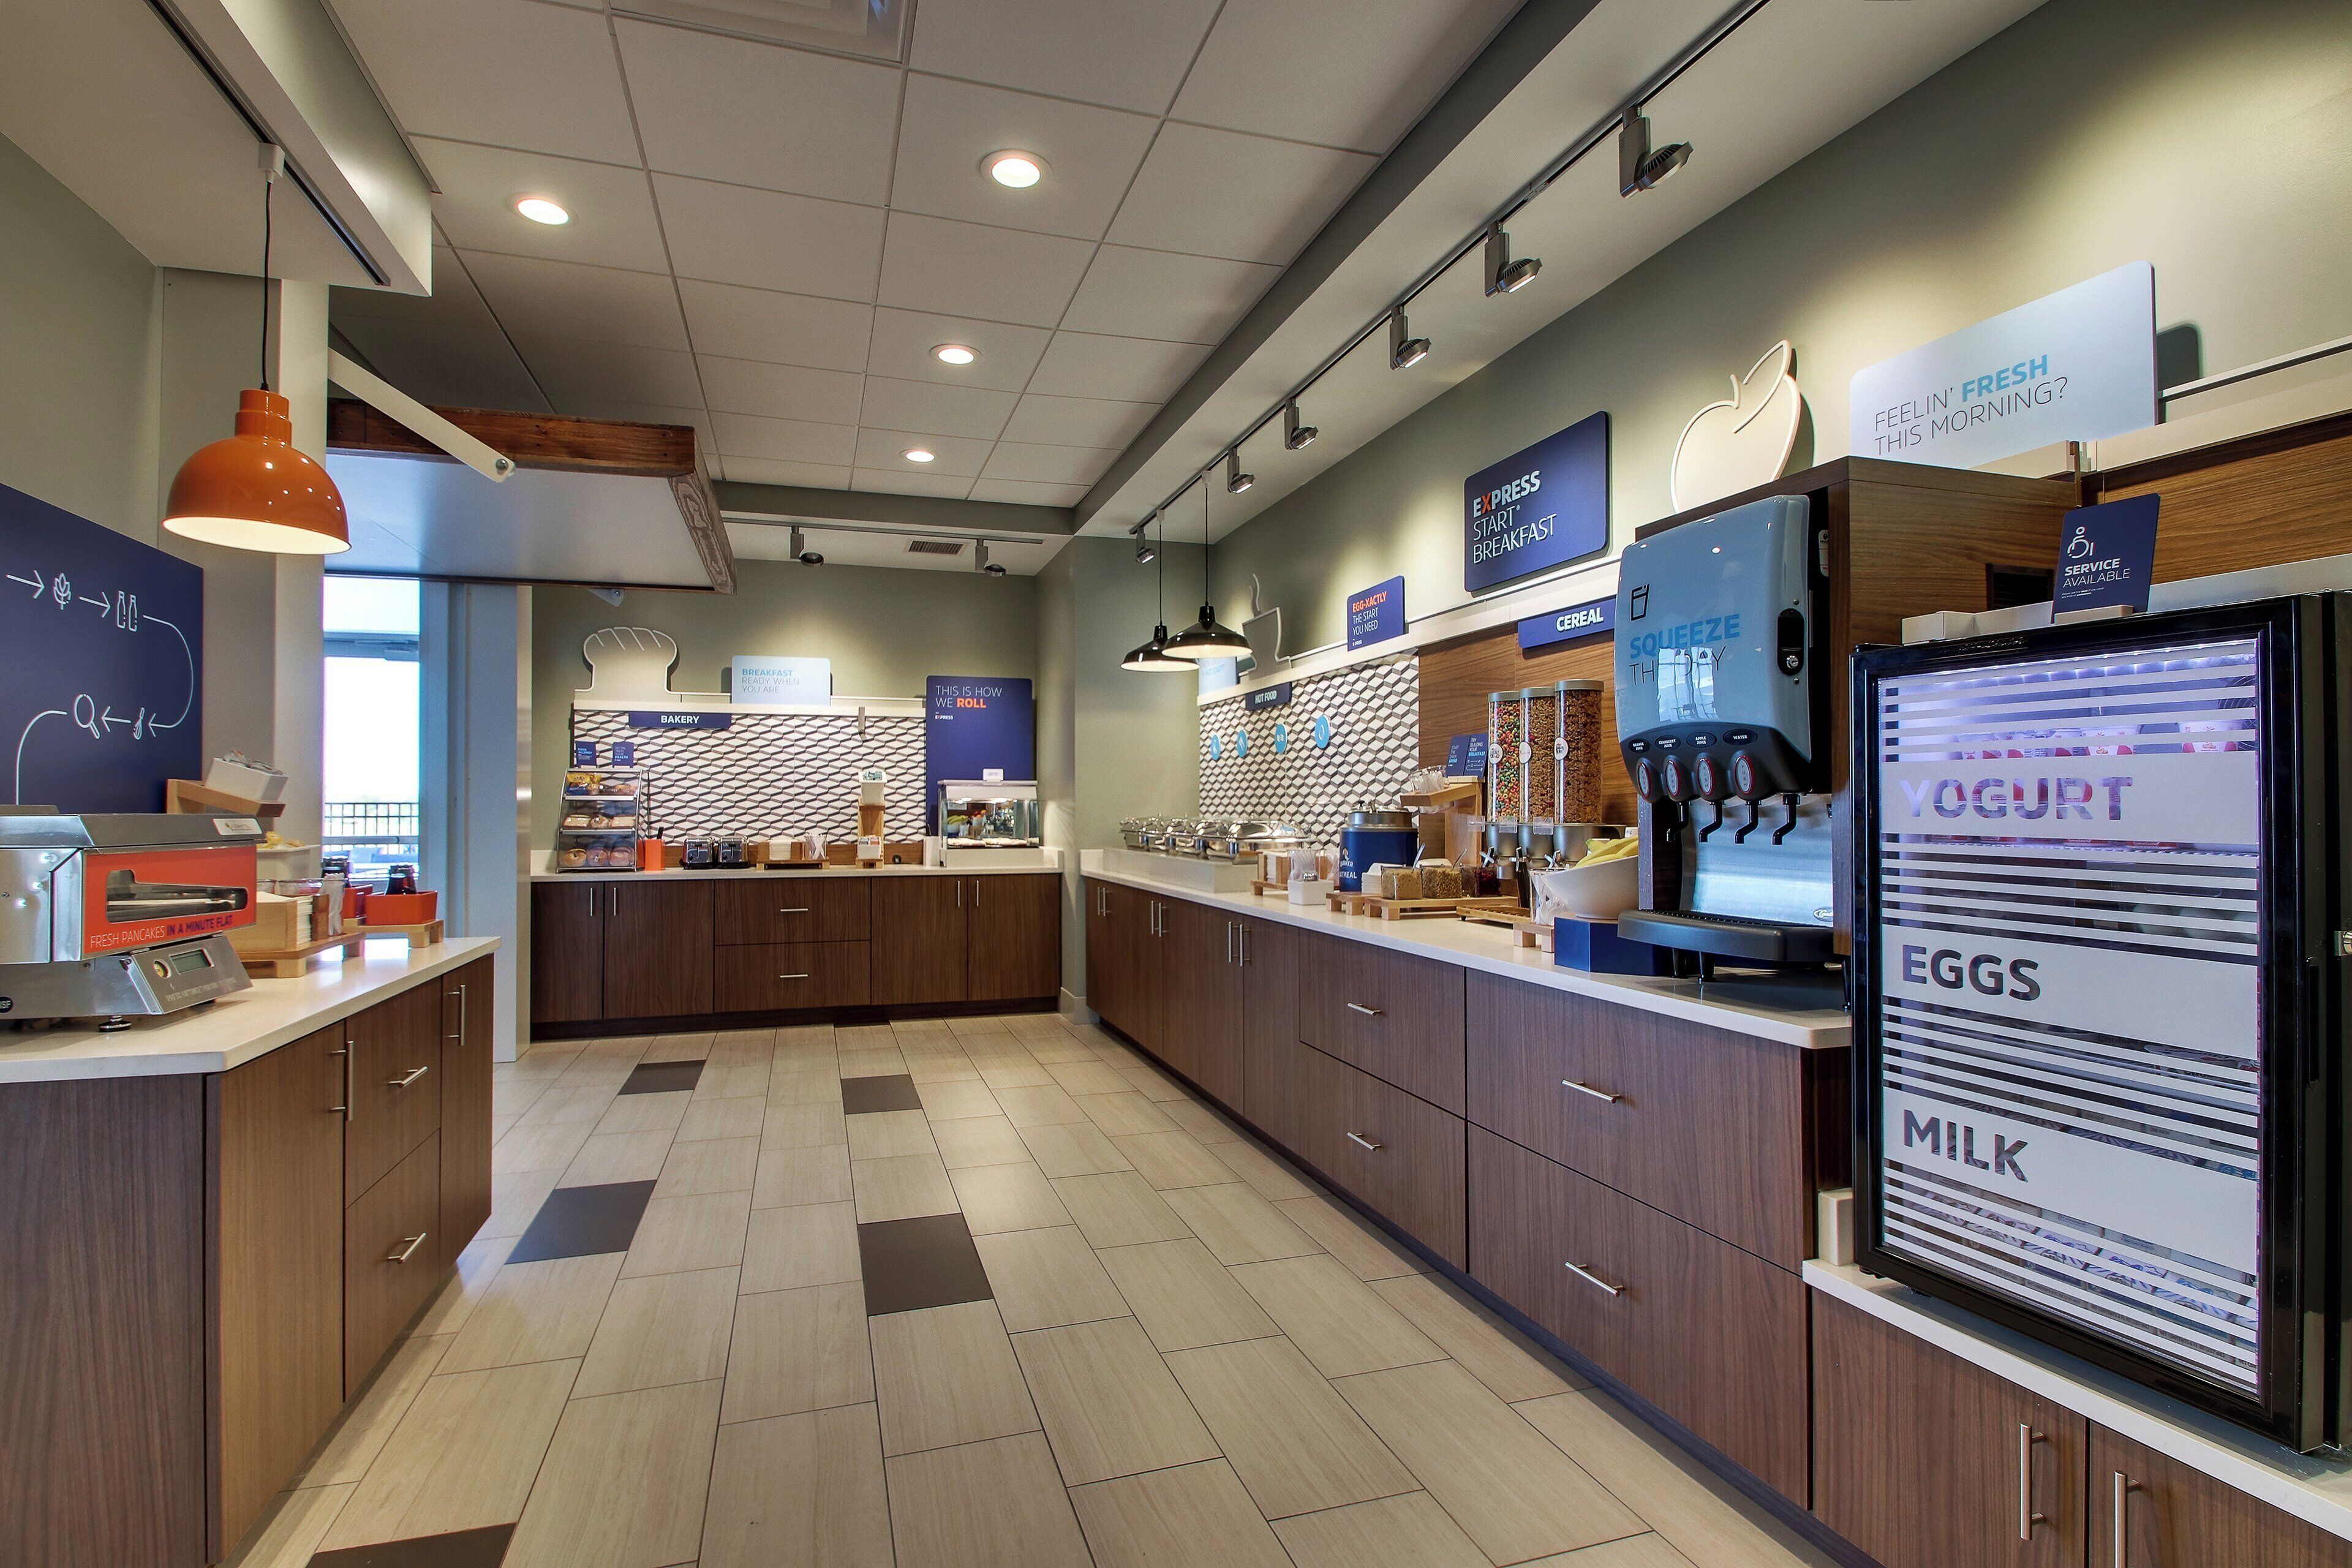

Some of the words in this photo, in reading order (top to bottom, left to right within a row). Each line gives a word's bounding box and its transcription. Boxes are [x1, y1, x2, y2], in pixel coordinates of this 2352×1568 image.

[1962, 354, 2048, 402] FRESH
[1874, 424, 1921, 456] THIS
[1931, 377, 2068, 439] MORNING?
[1473, 470, 1541, 518] EXPRESS
[1473, 513, 1558, 565] BREAKFAST
[2062, 568, 2130, 588] AVAILABLE
[2064, 558, 2120, 576] SERVICE
[1352, 591, 1387, 612] EGG-XACTLY
[1352, 613, 1362, 624] THE
[1363, 607, 1379, 621] START
[1556, 607, 1604, 631] CEREAL
[1352, 625, 1363, 636] YOU
[1364, 620, 1378, 632] NEED
[1630, 614, 1740, 659] SQUEEZE
[935, 685, 959, 696] THIS
[962, 686, 971, 697] IS
[975, 687, 1003, 697] HOW
[935, 697, 953, 707] WE
[956, 697, 987, 708] ROLL
[1255, 693, 1264, 704] HOT
[1264, 690, 1278, 702] FOOD
[660, 715, 700, 724] BAKERY
[1899, 777, 2134, 821] YOGURT
[90, 933, 120, 949] FRESH
[122, 925, 165, 944] PANCAKES
[167, 925, 176, 936] IN
[178, 923, 183, 934] A
[186, 918, 214, 932] MINUTE
[217, 914, 233, 928] FLAT
[1902, 944, 2041, 1001] EGGS
[1903, 1109, 2029, 1183] MILK
